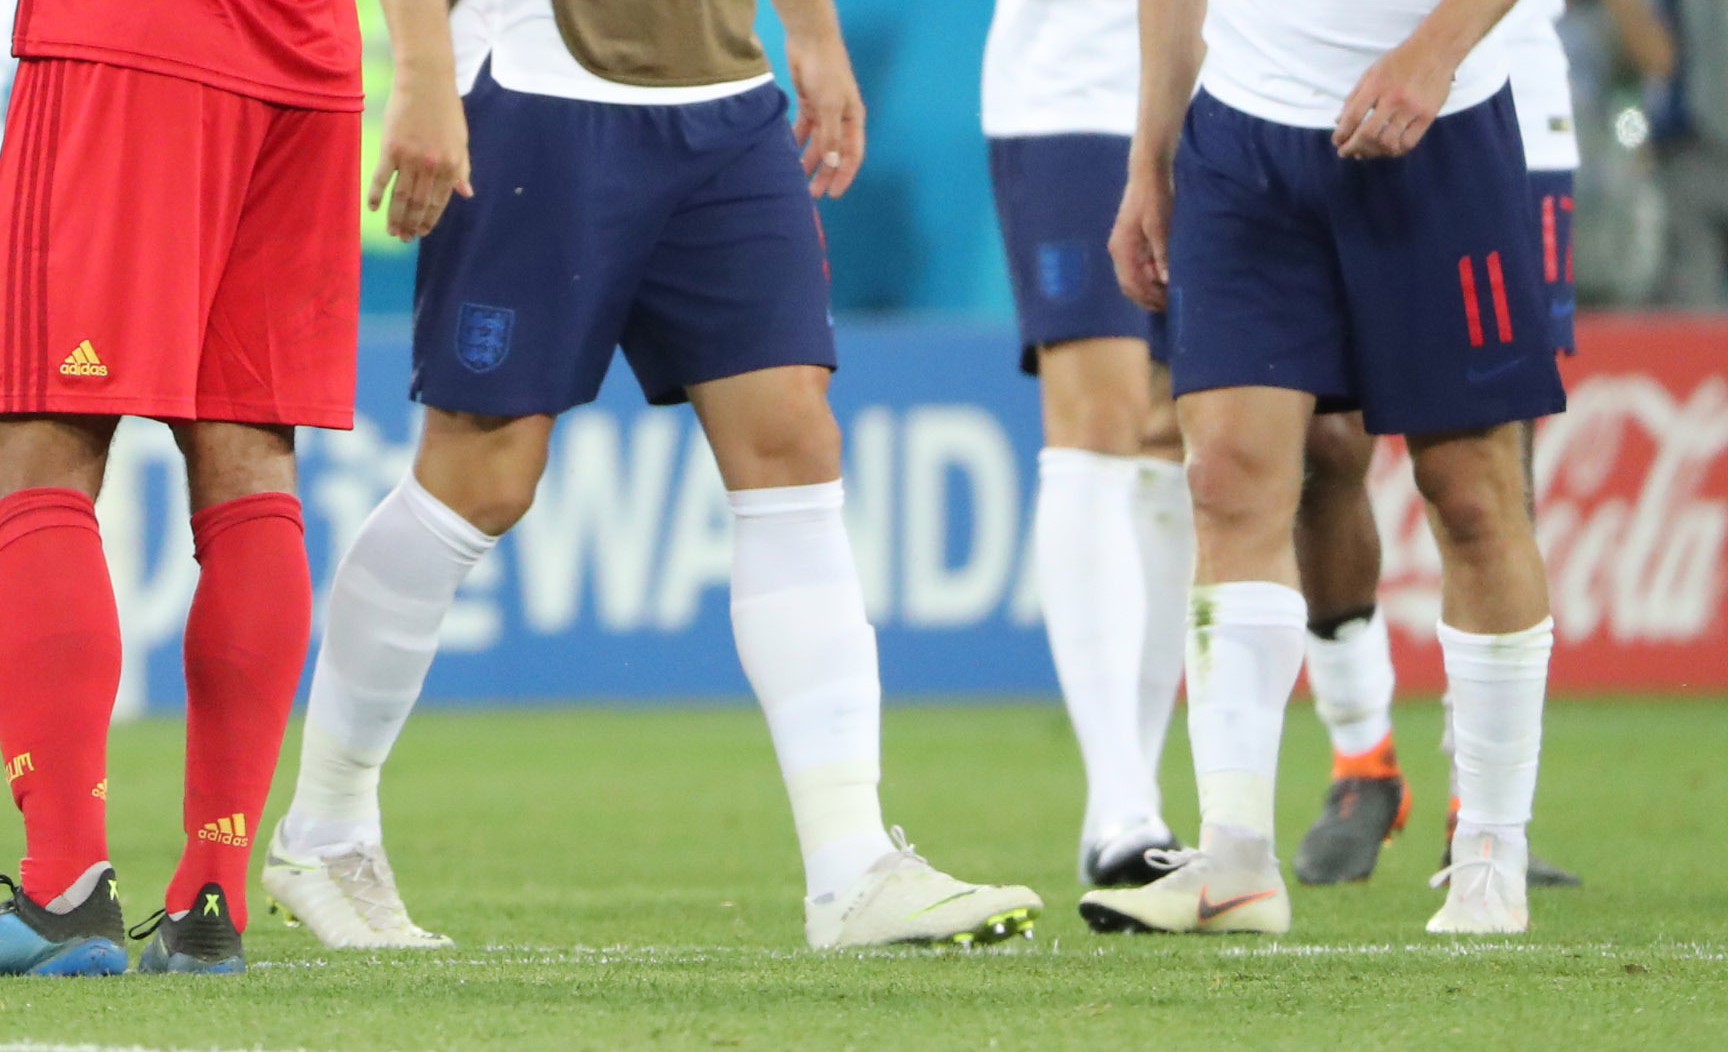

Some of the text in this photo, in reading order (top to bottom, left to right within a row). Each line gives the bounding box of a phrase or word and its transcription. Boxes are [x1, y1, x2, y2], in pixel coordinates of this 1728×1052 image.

[1458, 250, 1514, 346] 11
[60, 361, 108, 377] adidas
[198, 828, 249, 847] adidas
